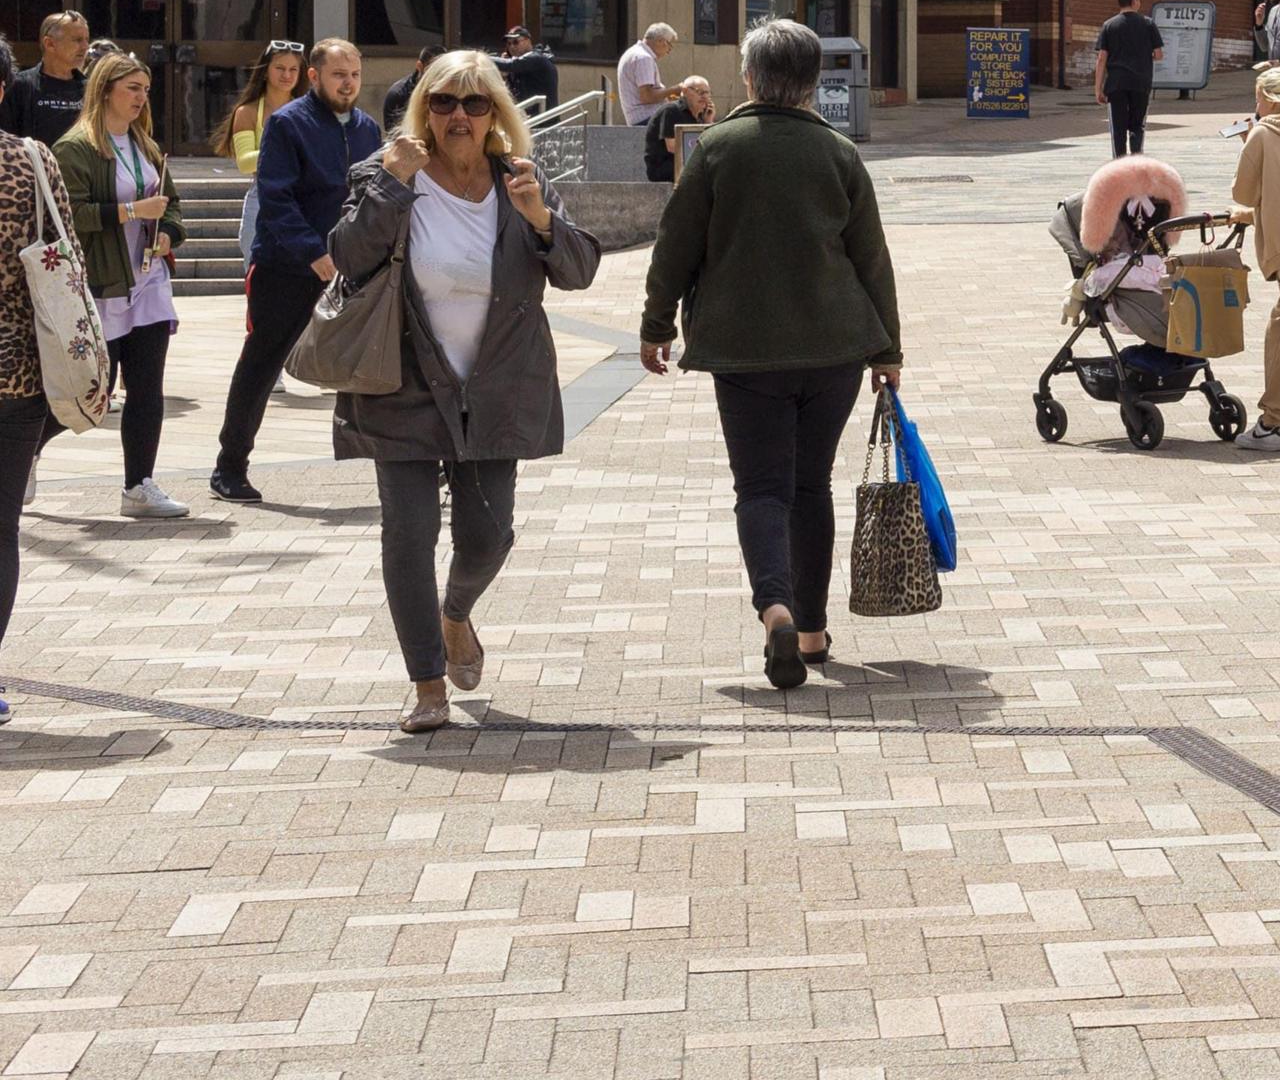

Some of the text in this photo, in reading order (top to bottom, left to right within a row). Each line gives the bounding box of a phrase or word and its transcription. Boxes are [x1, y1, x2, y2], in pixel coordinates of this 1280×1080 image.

[969, 32, 1022, 42] REPAIR IT
[969, 41, 1022, 52] FOR YOU
[970, 52, 1021, 62] COMPUTER
[980, 62, 1012, 71] STORE
[983, 71, 1001, 79] THE
[1002, 71, 1026, 80] BACK
[968, 79, 1024, 88] OF SISTERS
[984, 88, 1010, 96] SHOP
